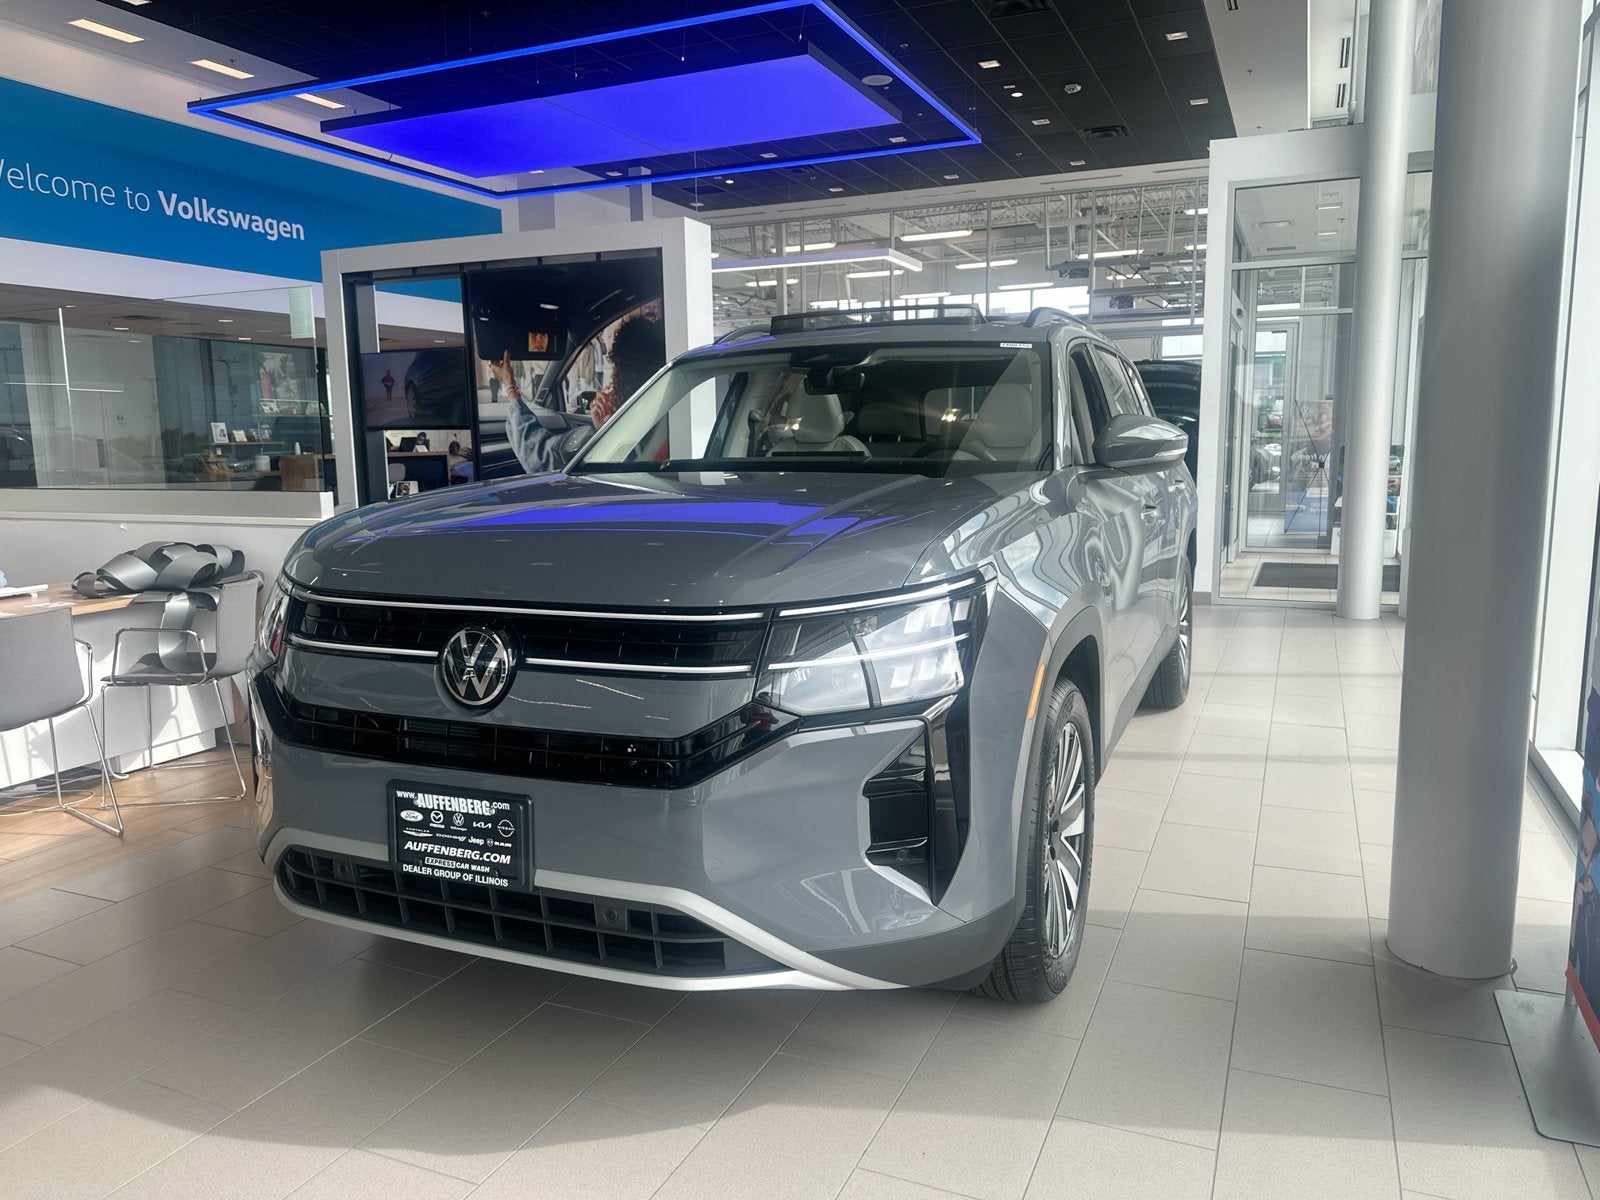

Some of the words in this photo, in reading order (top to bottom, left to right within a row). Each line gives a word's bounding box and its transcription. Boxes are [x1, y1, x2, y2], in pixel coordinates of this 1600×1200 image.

[0, 159, 116, 206] elcome
[124, 186, 150, 212] to
[157, 190, 305, 241] Volkswagen
[404, 840, 511, 865] AUFFENBERG.COM
[468, 836, 484, 846] Jeep
[403, 864, 432, 876] DEALER
[434, 867, 461, 880] GROUP
[463, 872, 474, 882] OF
[475, 874, 509, 887] ILLINOIS
[426, 857, 456, 868] EXPRESS
[456, 862, 470, 870] CAR
[471, 864, 490, 873] WASH
